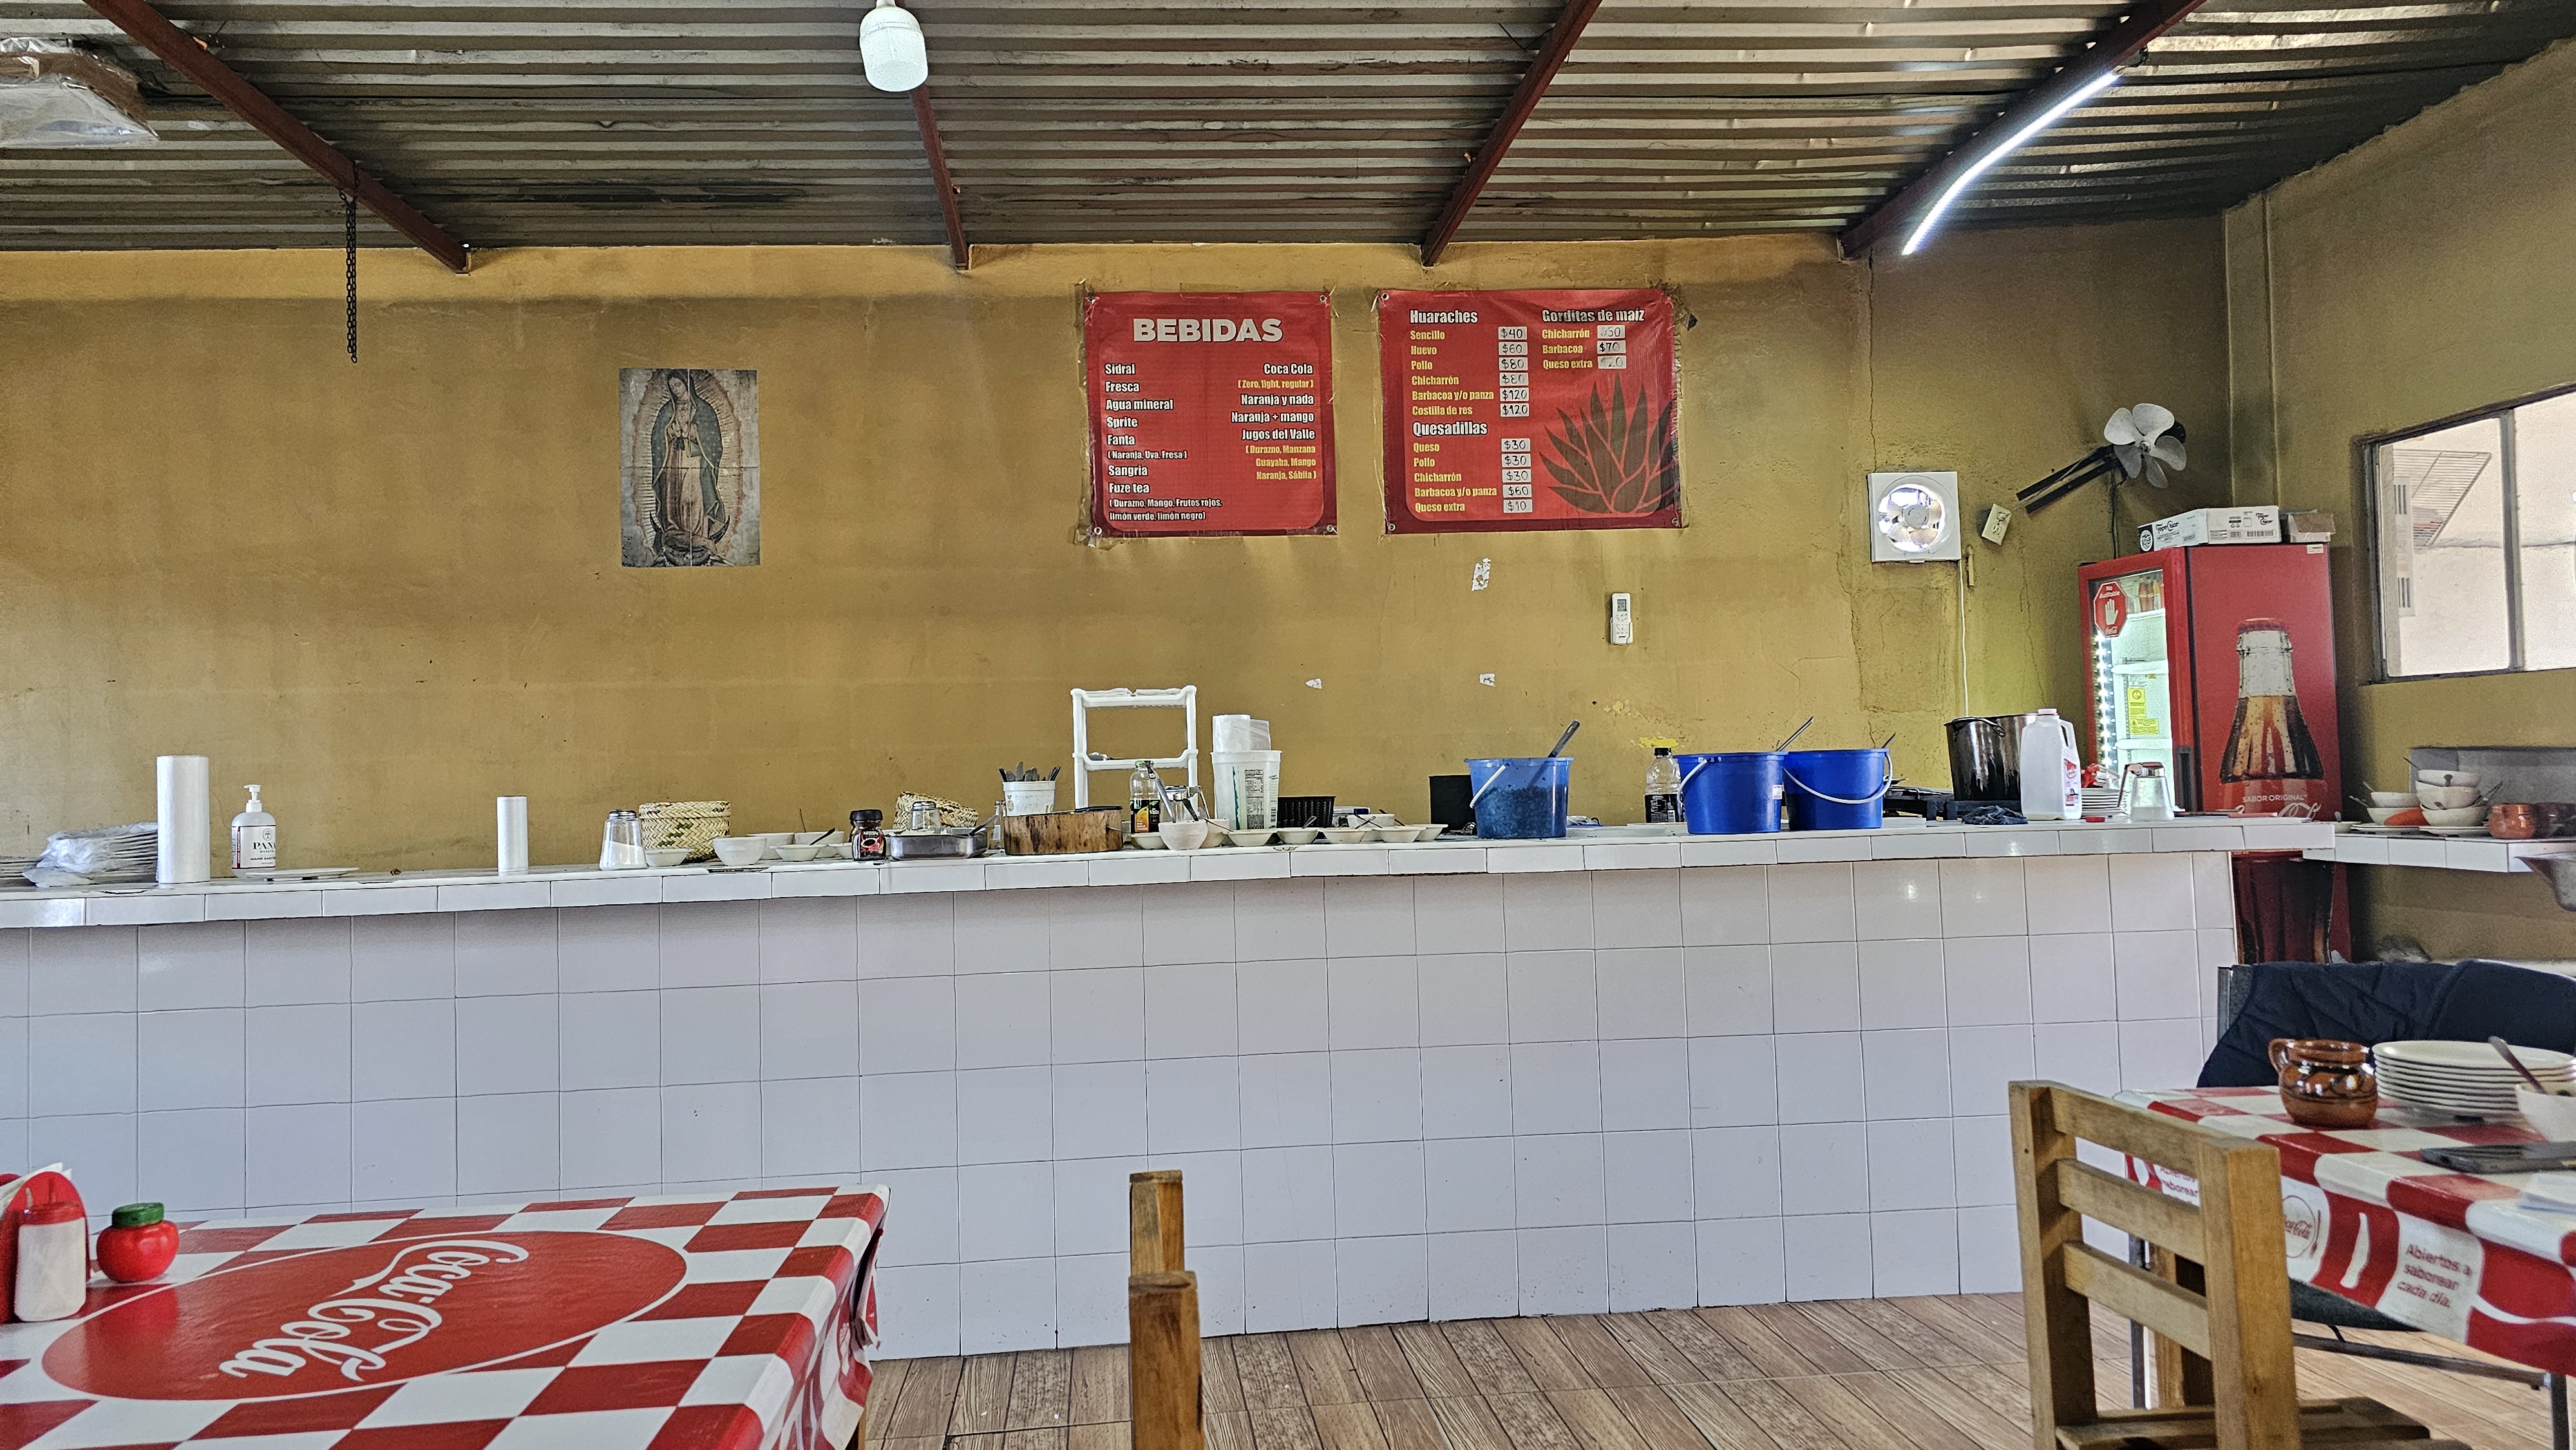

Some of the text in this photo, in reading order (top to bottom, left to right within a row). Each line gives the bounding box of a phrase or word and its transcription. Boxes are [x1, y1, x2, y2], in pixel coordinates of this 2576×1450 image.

[1410, 310, 1478, 323] Huaraches
[1542, 308, 1645, 322] Gorditas de maíz
[1133, 318, 1283, 342] BEBIDAS
[1410, 328, 1523, 340] Sencillo $40
[1542, 329, 1589, 339] Chicharrón
[1411, 343, 1522, 355] Huevo $60
[1542, 342, 1620, 353] Barbacoa $70
[1105, 364, 1135, 374] Sidral
[1264, 364, 1313, 374] Coca Cola
[1411, 358, 1524, 370] Pollo $80
[1543, 360, 1569, 370] Queso
[1571, 360, 1593, 368] extra
[1412, 373, 1525, 385] Chicharrón $80
[1106, 381, 1139, 392] Fresca
[1241, 394, 1314, 406] Naranja y nada
[1412, 389, 1527, 400] Barbacoa y/o panza $120
[1106, 399, 1173, 411] Agua mineral
[1412, 404, 1528, 415] Costilla de res $120
[1106, 417, 1138, 428] Sprite
[1231, 412, 1270, 423] Naranja
[1280, 413, 1314, 423] mango
[1242, 429, 1315, 441] Jugos del Valle
[1413, 422, 1488, 437] Quesadillas
[1108, 435, 1135, 445] Fanta
[1283, 445, 1316, 453] Manzana
[1414, 440, 1526, 453] Queso $30
[1256, 458, 1316, 467] Guayaba, Mango
[1414, 455, 1526, 467] Pollo $30
[1108, 465, 1148, 476] Sangria
[1256, 471, 1287, 480] Naranja,
[1414, 470, 1528, 482] Chicharrón $30
[1109, 483, 1150, 493] Fuze tea
[1415, 485, 1528, 497] Barbacoa y/o panza $60
[1176, 498, 1200, 507] Frutos
[1416, 501, 1526, 513] Queso extra $10
[1110, 512, 1132, 520] limón
[1157, 512, 1179, 520] limón
[1181, 511, 1206, 520] negro)
[2406, 1243, 2460, 1273] Abiertos
[2405, 1264, 2460, 1290] saborear
[2397, 1281, 2426, 1299] cada
